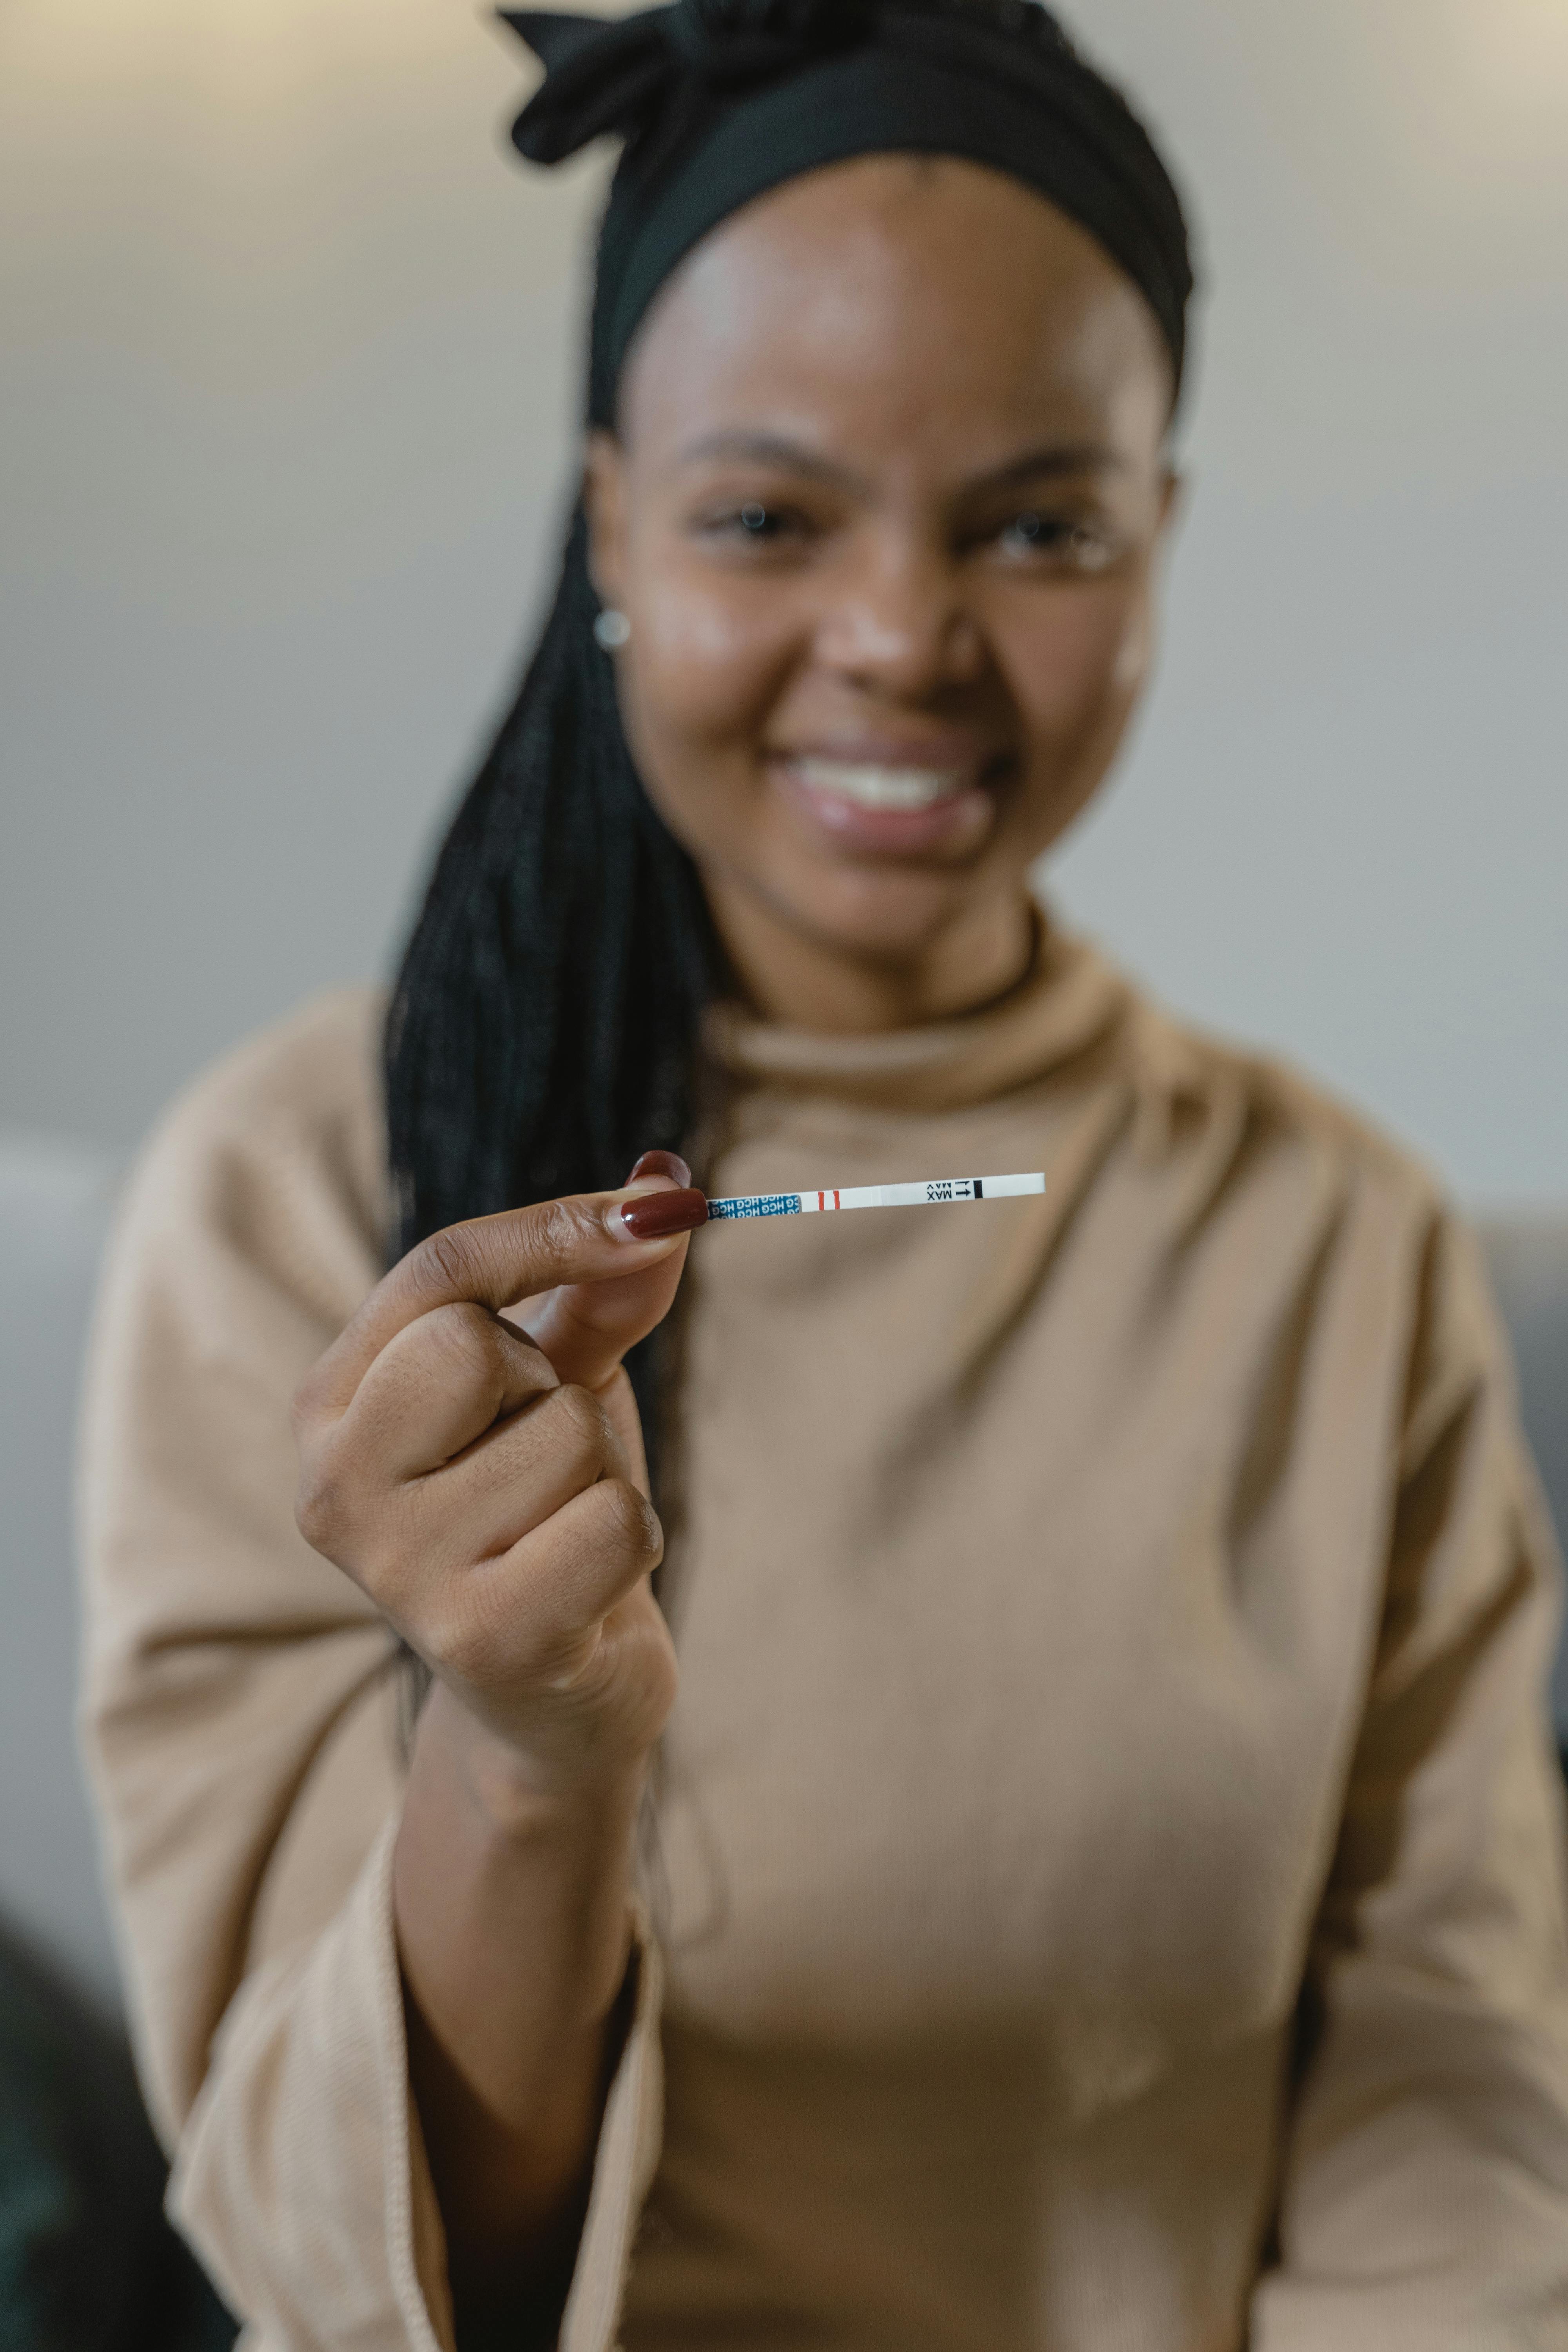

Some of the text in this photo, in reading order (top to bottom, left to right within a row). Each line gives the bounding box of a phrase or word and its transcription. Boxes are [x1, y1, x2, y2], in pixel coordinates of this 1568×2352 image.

[927, 1190, 952, 1201] MAX
[712, 1203, 734, 1215] HCG
[736, 1198, 759, 1209] HCG
[762, 1201, 784, 1214] HCG
[737, 1207, 760, 1218] HCG
